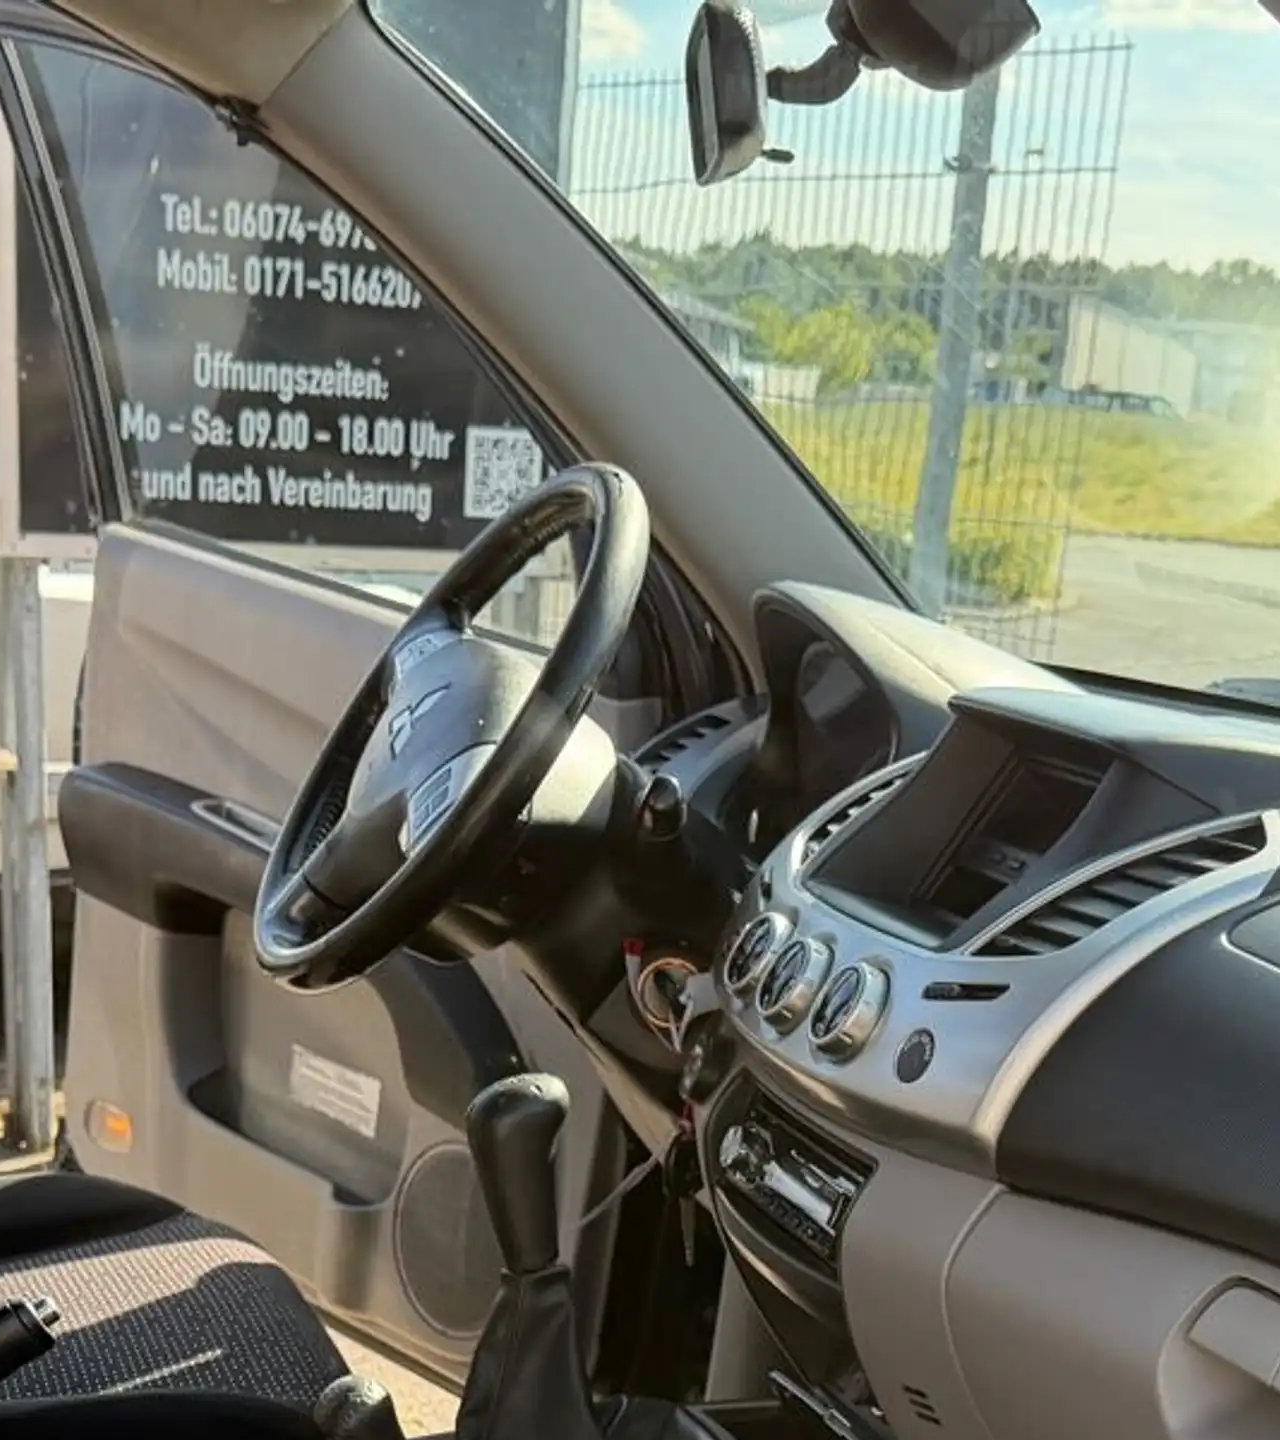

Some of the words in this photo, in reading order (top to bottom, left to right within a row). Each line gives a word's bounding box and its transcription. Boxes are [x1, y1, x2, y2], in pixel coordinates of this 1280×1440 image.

[160, 193, 217, 235] Tel.:
[157, 249, 238, 294] Mobil:
[193, 342, 389, 402] Öffnungszeiten:
[119, 401, 160, 440] Mo
[191, 405, 233, 447] Sa:
[238, 408, 308, 452] 09.00
[338, 414, 404, 459] 18.00
[409, 419, 456, 462] Uhr
[141, 464, 192, 502] und
[198, 464, 261, 505] nach
[266, 468, 432, 522] Vereinbarung
